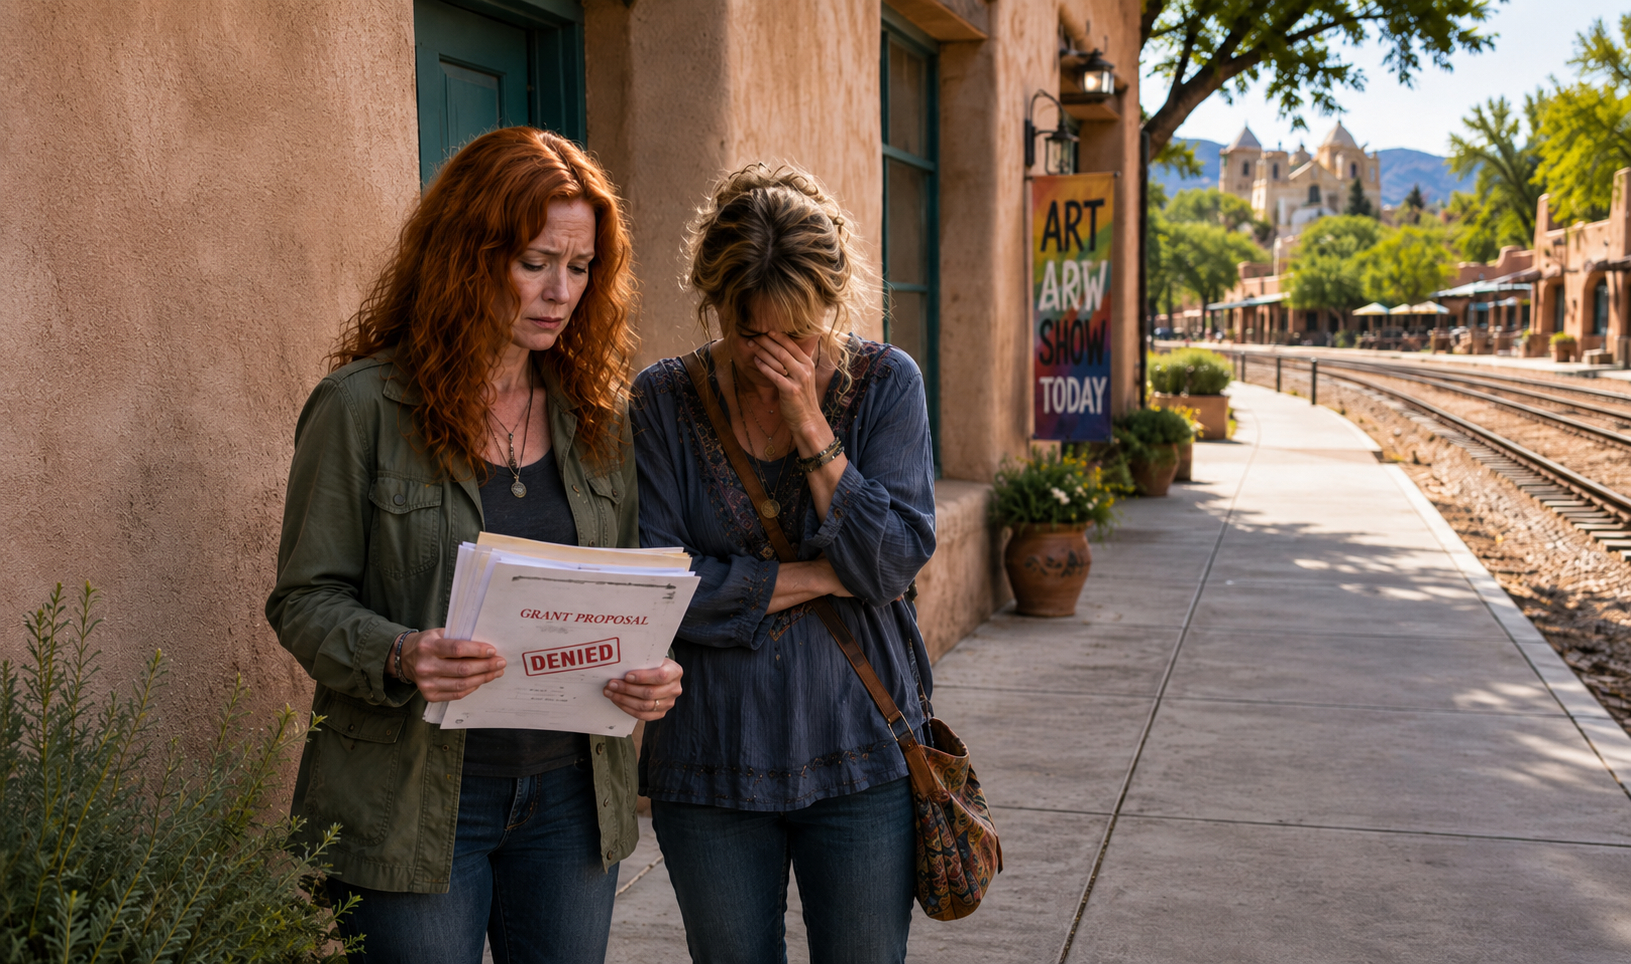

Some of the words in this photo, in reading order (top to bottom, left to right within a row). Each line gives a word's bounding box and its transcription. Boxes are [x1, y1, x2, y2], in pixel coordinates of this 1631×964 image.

[1040, 198, 1105, 252] ART
[1038, 259, 1108, 311] ARW
[1038, 318, 1107, 367] SHOW
[1039, 376, 1108, 414] TODAY
[520, 608, 573, 622] GRANT
[574, 613, 649, 625] PROPOSAL
[530, 643, 614, 672] DENIED
